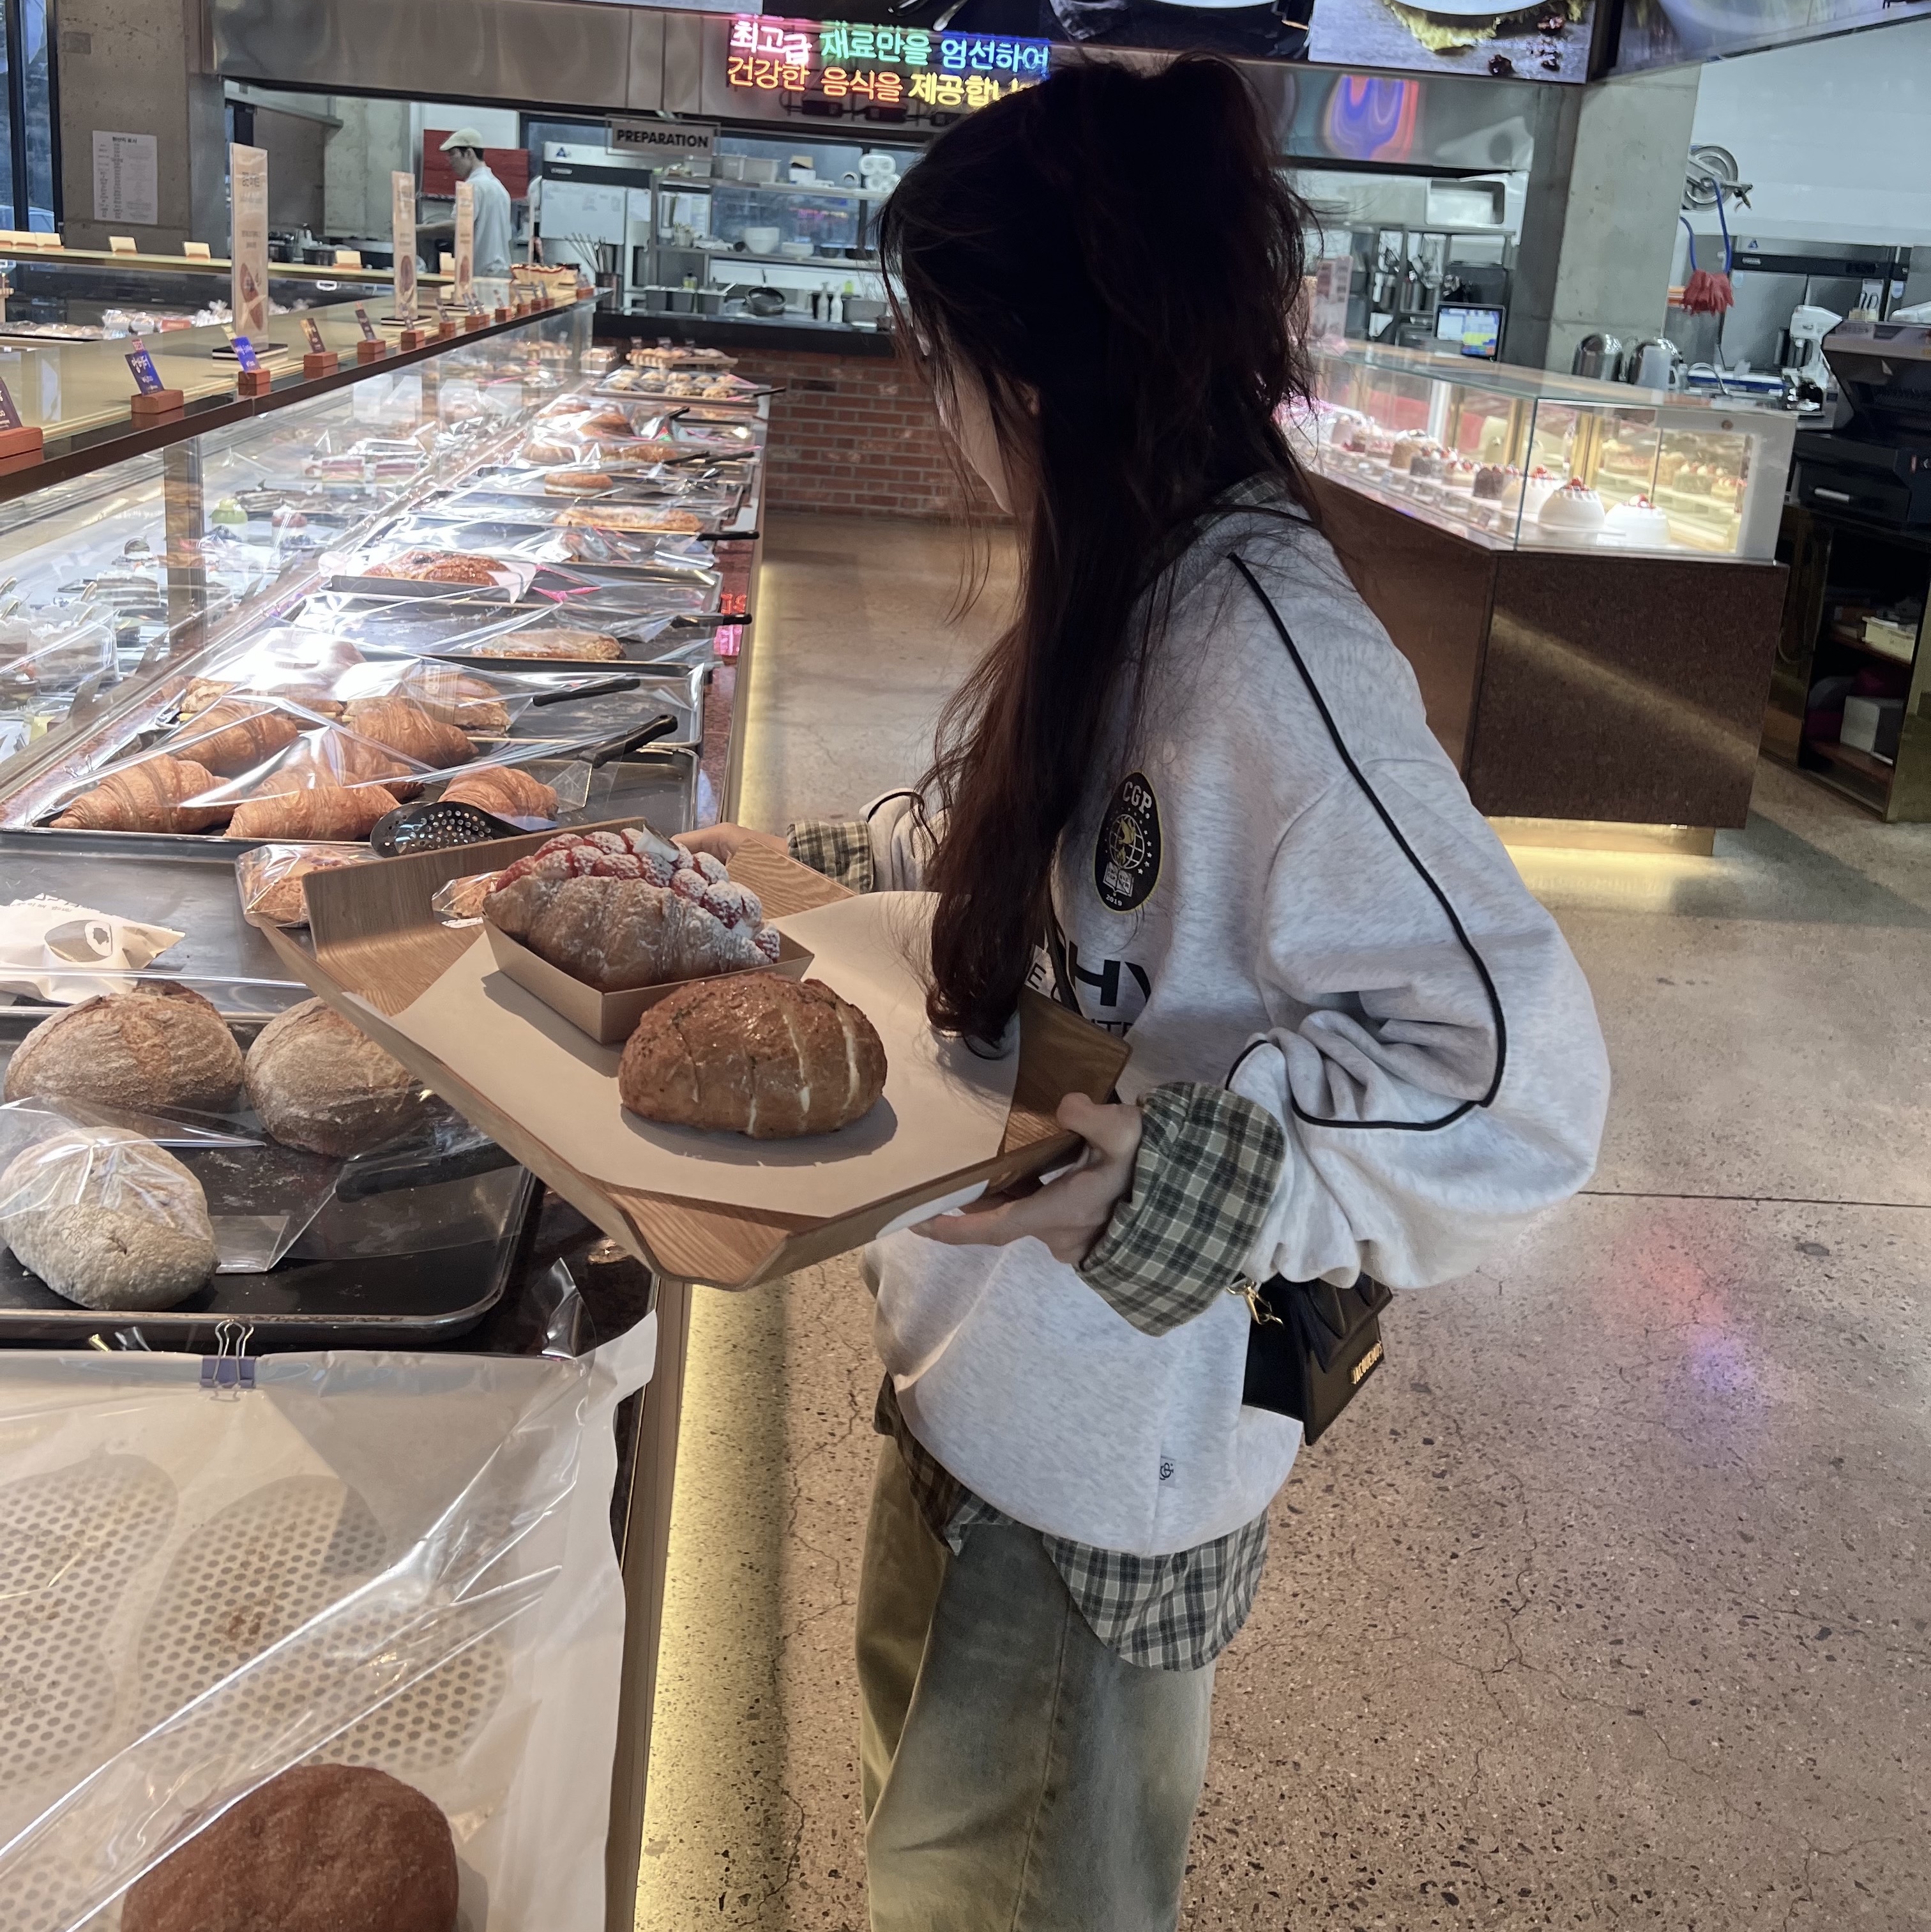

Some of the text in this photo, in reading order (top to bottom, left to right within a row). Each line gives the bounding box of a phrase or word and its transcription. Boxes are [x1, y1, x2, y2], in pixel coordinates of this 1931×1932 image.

[730, 20, 1049, 75] 최고급 재료만을 엄선하여
[727, 55, 810, 91] 건강한
[821, 66, 904, 102] 음식을
[616, 129, 709, 148] PREPARATION
[1105, 894, 1123, 907] 2019
